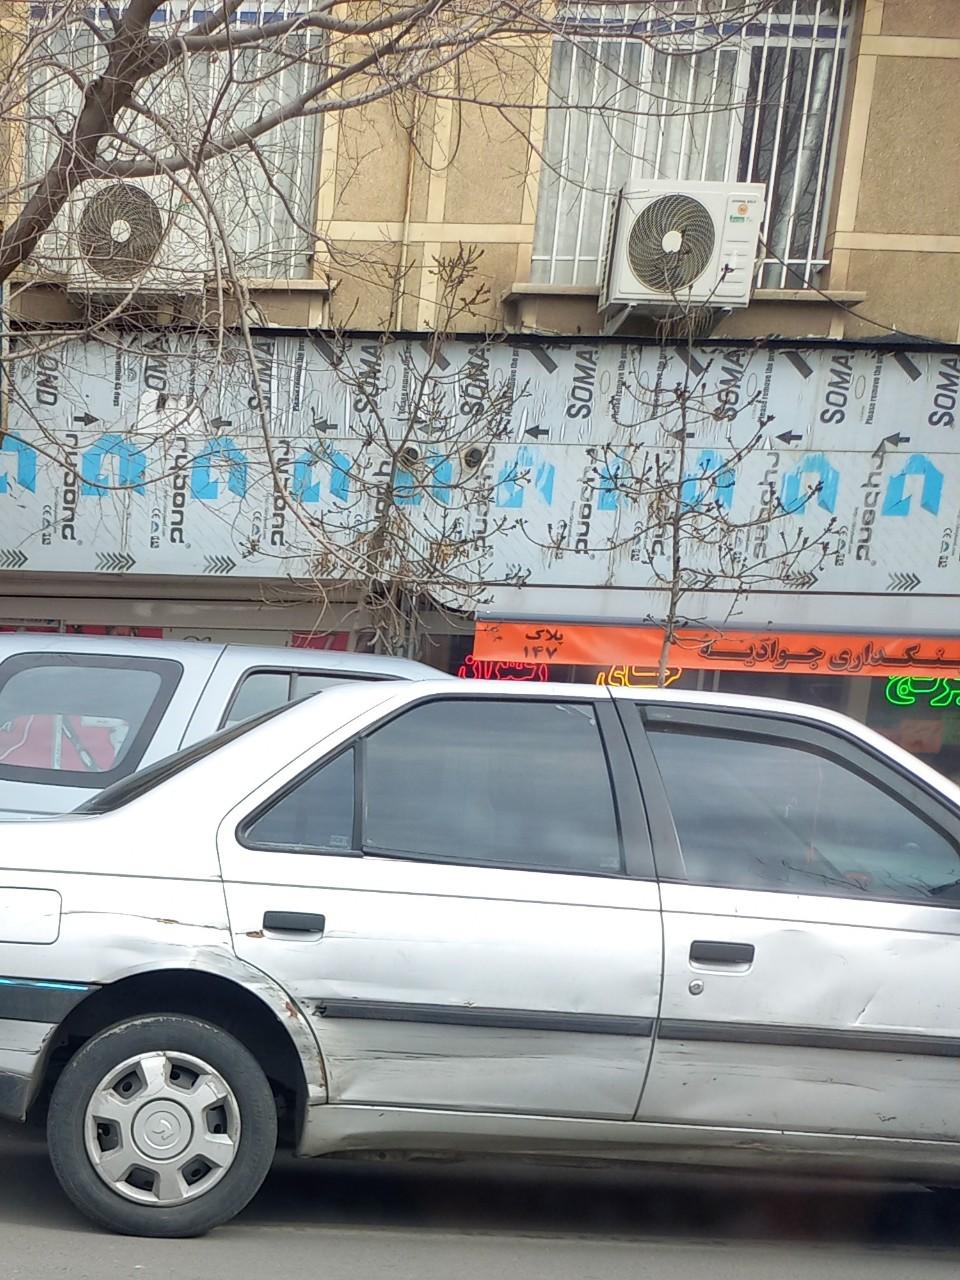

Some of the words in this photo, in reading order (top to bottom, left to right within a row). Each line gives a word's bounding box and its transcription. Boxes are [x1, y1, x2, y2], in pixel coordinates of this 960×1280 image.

[566, 349, 598, 419] SOMA
[819, 354, 855, 425] SOMA
[928, 358, 960, 427] SOMA
[523, 646, 558, 660] ۱۴۷
[525, 628, 564, 646] پلاک
[828, 640, 960, 672] نکداری
